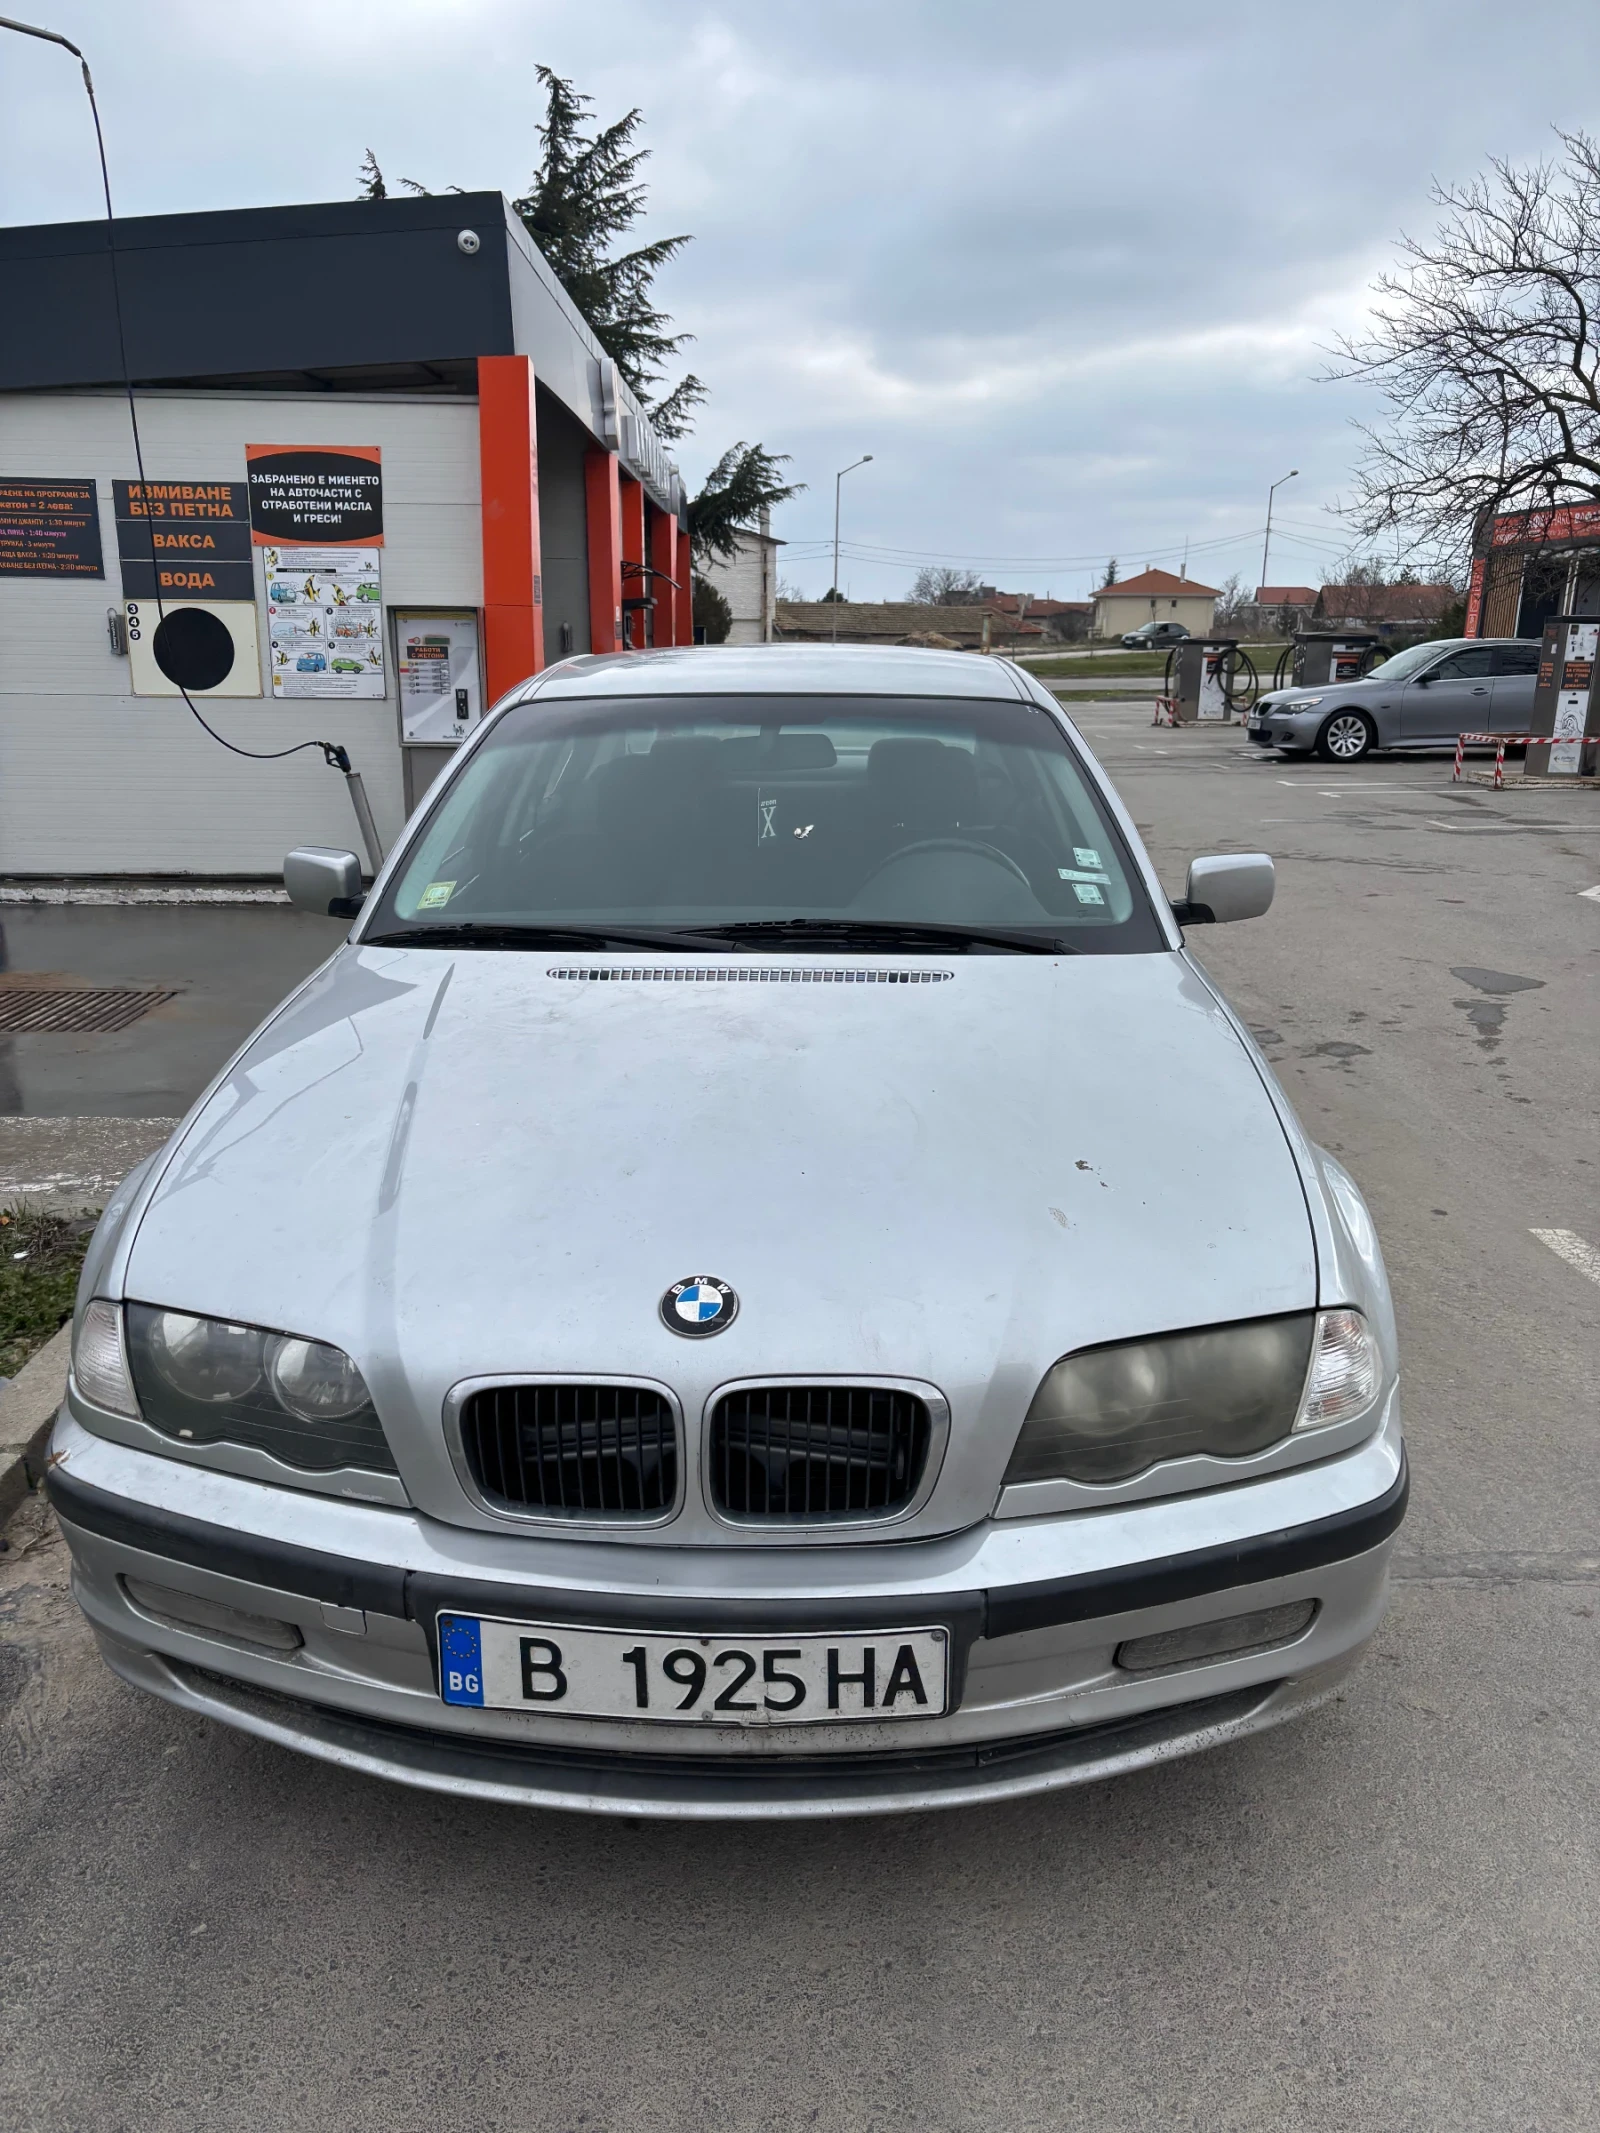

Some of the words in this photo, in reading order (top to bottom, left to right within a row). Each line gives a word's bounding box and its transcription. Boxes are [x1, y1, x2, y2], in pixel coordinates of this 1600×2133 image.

[251, 474, 315, 484] ЗАБРАНЕНО
[318, 476, 325, 484] Е
[328, 476, 380, 486] МИЕНЕТО
[128, 485, 232, 500] ИЗМИВАНЕ
[270, 488, 286, 496] НА
[288, 488, 352, 498] АВТОЧАСТИ
[354, 488, 362, 498] С
[130, 502, 165, 516] БЕЗ
[171, 503, 233, 517] ПЕТНА
[262, 500, 332, 510] ОТРАБОТЕНИ
[334, 501, 372, 511] МАСЛА
[293, 514, 301, 522] И
[304, 514, 342, 524] ГРЕСИ!
[153, 534, 215, 548] ВАКСА
[160, 572, 215, 588] ВОДА
[130, 618, 138, 626] 4
[761, 806, 776, 838] X
[670, 1277, 731, 1294] BMW
[519, 1636, 568, 1701] B
[622, 1645, 806, 1712] 1925
[827, 1644, 928, 1710] HA
[449, 1671, 479, 1694] BG
